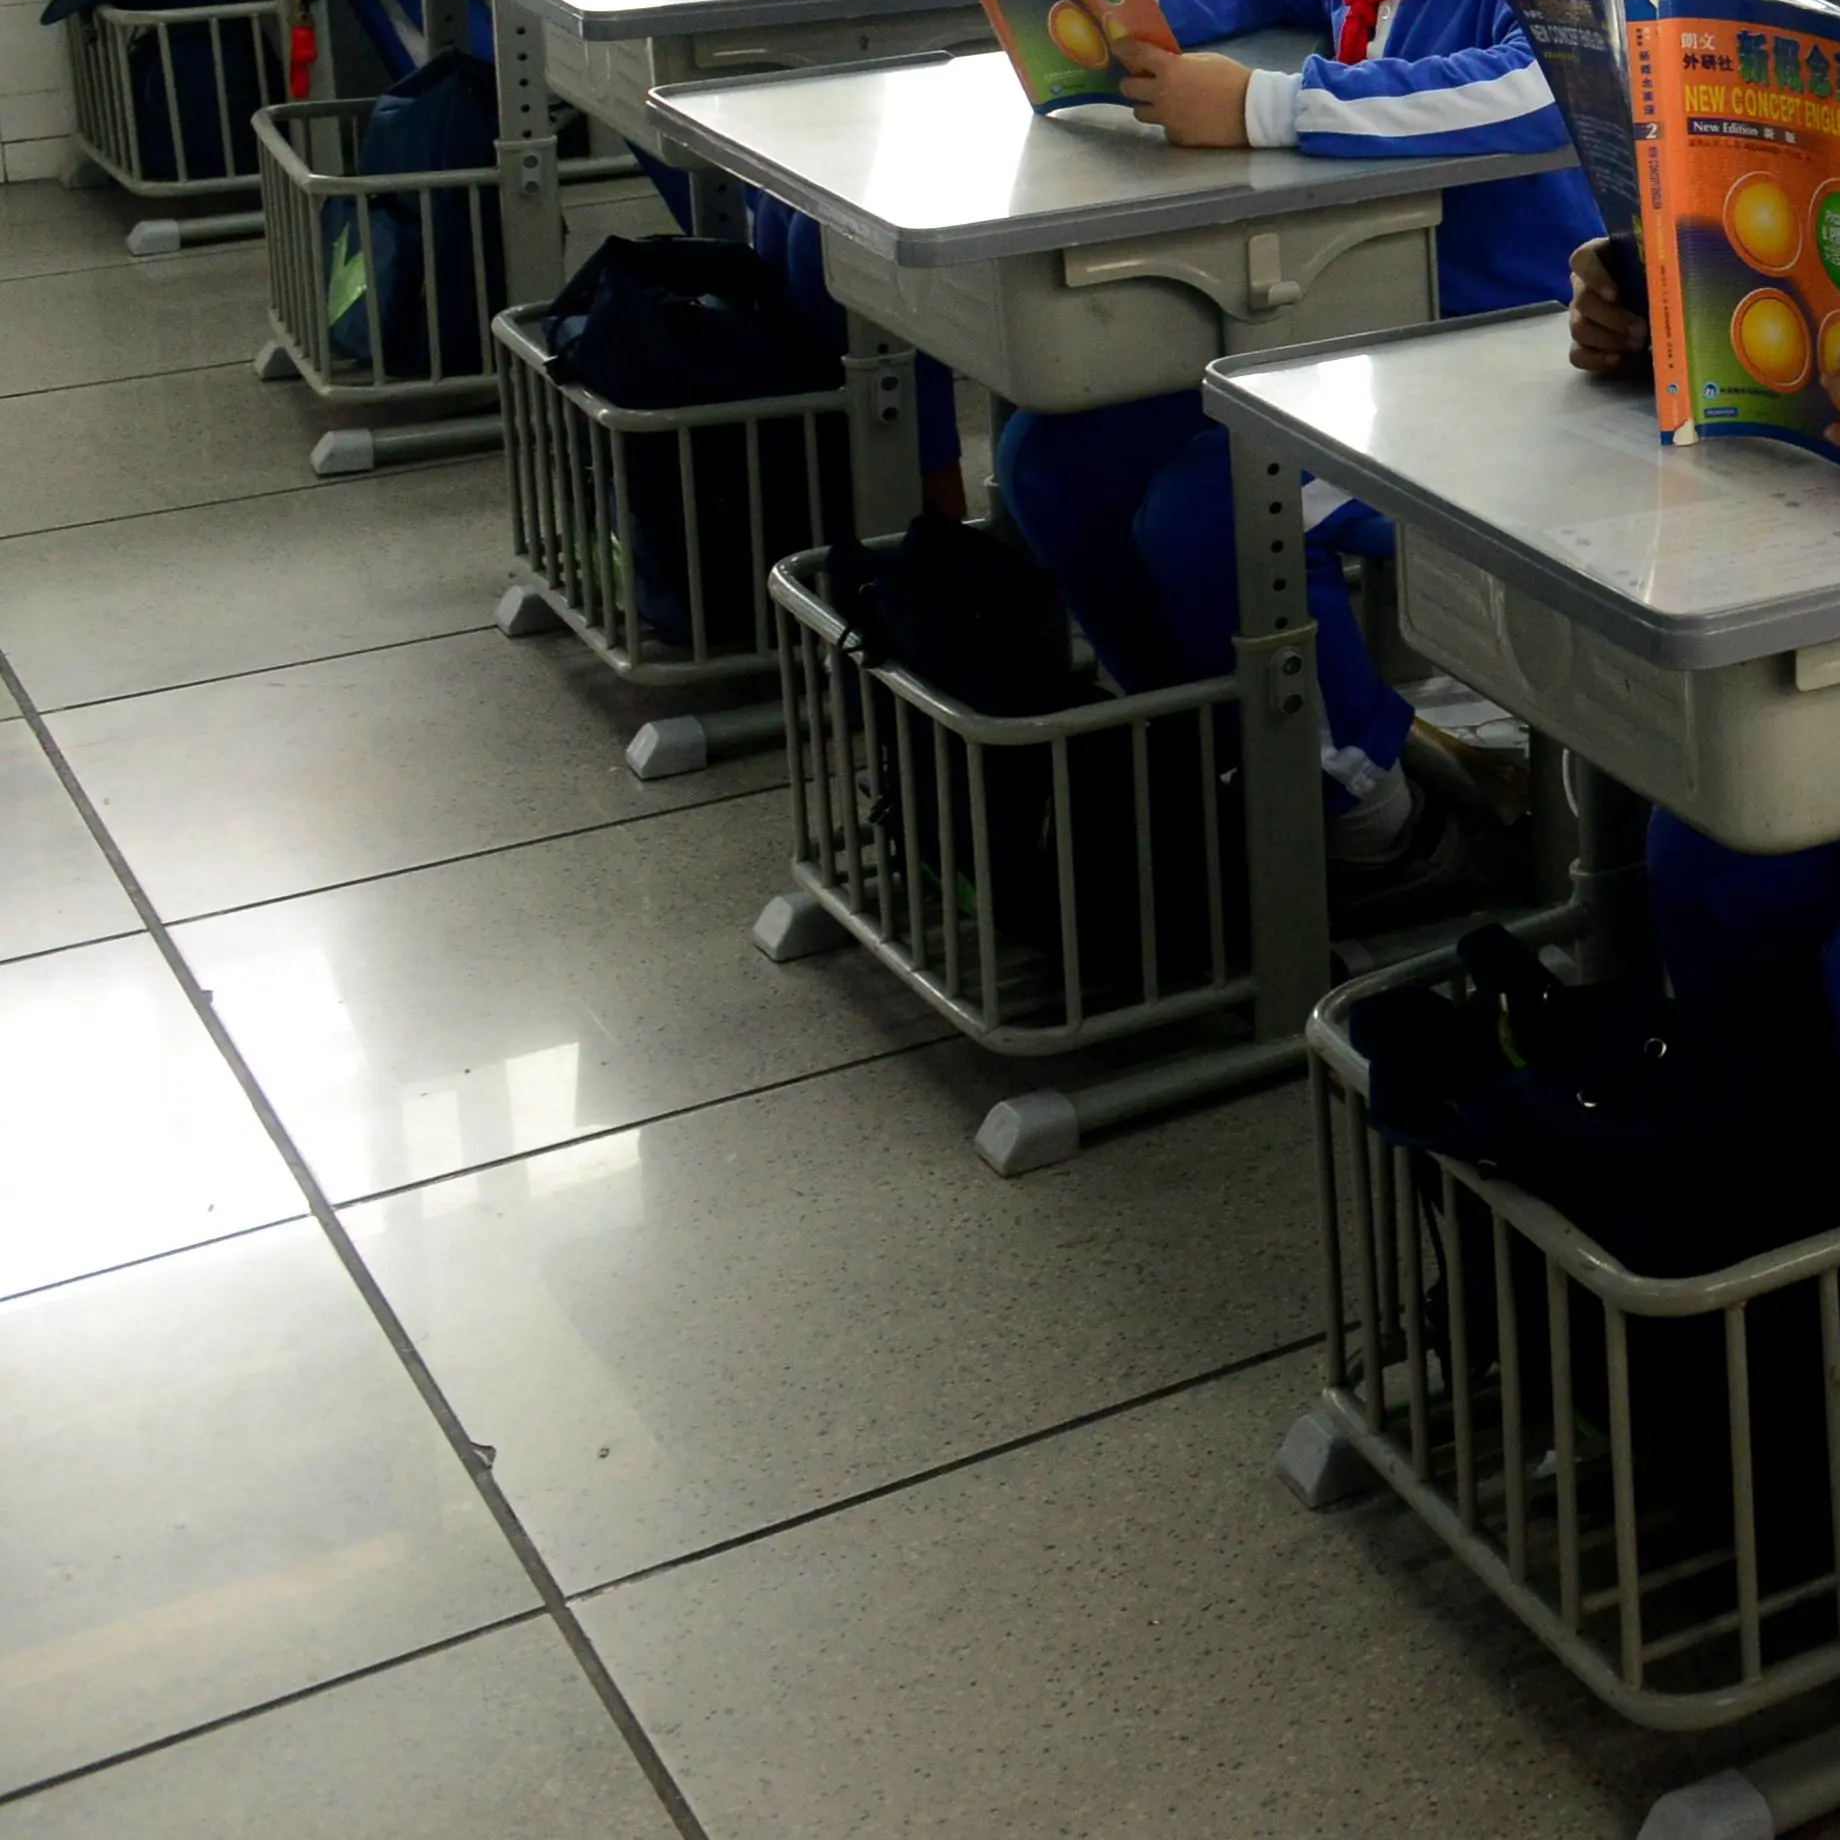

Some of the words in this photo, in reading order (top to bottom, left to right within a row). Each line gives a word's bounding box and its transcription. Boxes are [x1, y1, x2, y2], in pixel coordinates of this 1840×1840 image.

[1683, 53, 1734, 71] 外研社
[1685, 85, 1725, 113] NEW
[1732, 87, 1802, 124] CONCEPT
[1645, 123, 1658, 139] 2
[1693, 121, 1720, 132] New
[1722, 122, 1758, 136] Edition
